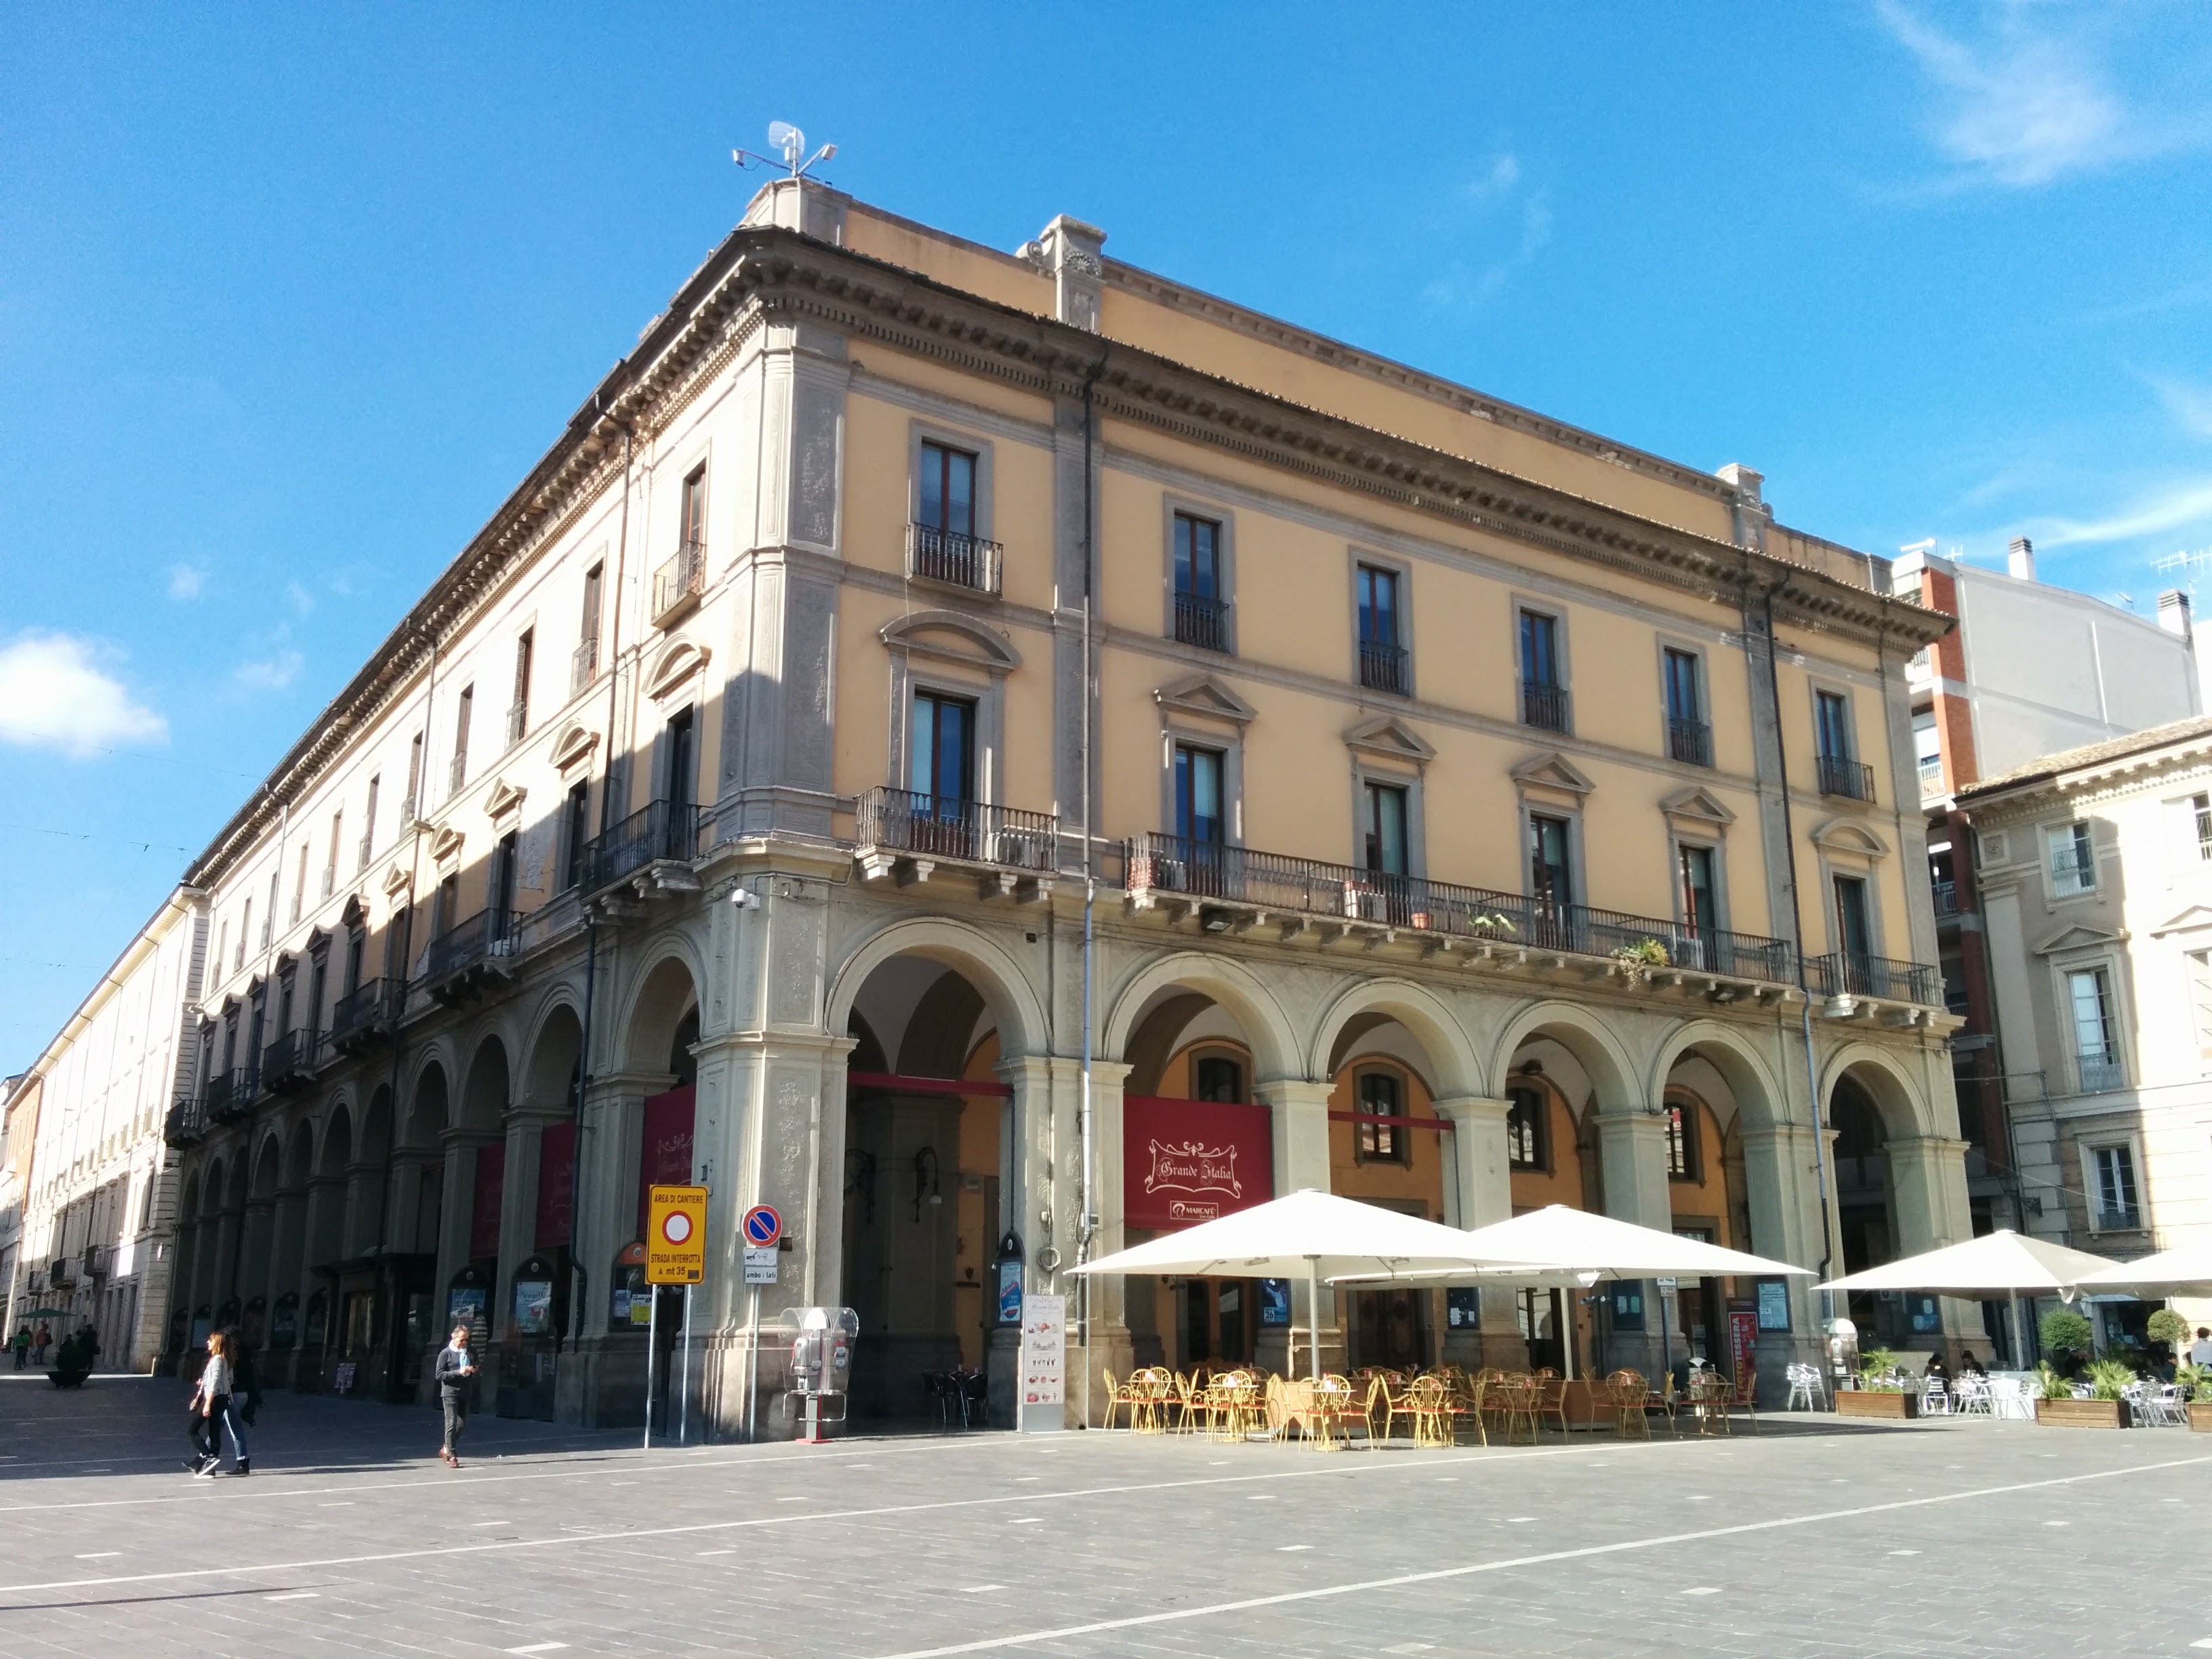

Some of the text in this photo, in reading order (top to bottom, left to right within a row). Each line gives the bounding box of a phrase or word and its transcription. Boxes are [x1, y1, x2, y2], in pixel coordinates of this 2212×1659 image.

[1159, 1160, 1231, 1181] Grande Italia
[654, 1194, 703, 1204] AREA DI CANTIERE
[651, 1254, 701, 1263] STRADA INTERROTTA
[665, 1267, 675, 1275] mt
[676, 1267, 686, 1275] 35
[1265, 1311, 1273, 1319] 26
